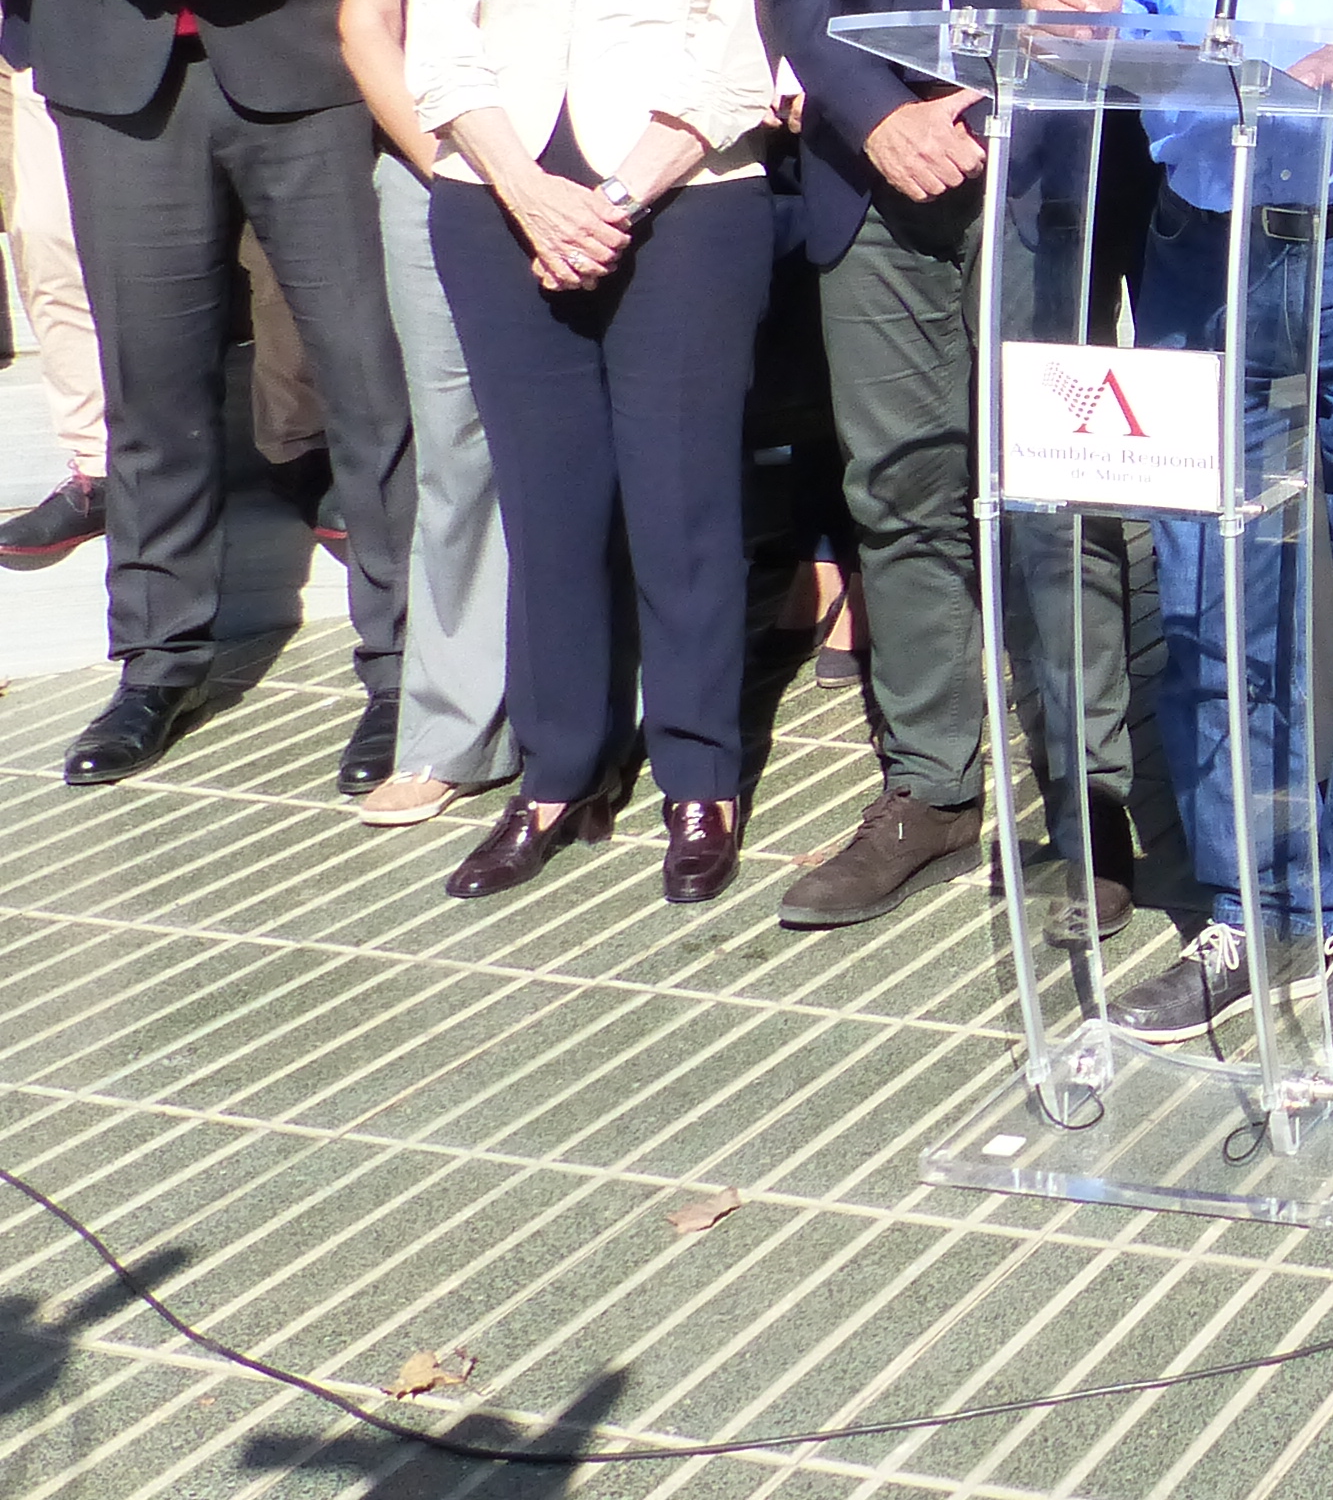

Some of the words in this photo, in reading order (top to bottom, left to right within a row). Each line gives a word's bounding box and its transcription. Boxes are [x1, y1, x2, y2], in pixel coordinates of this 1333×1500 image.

[1010, 442, 1112, 463] Asamblea
[1121, 449, 1215, 470] Regional
[1070, 467, 1088, 480] de
[1095, 469, 1152, 484] Murcia
